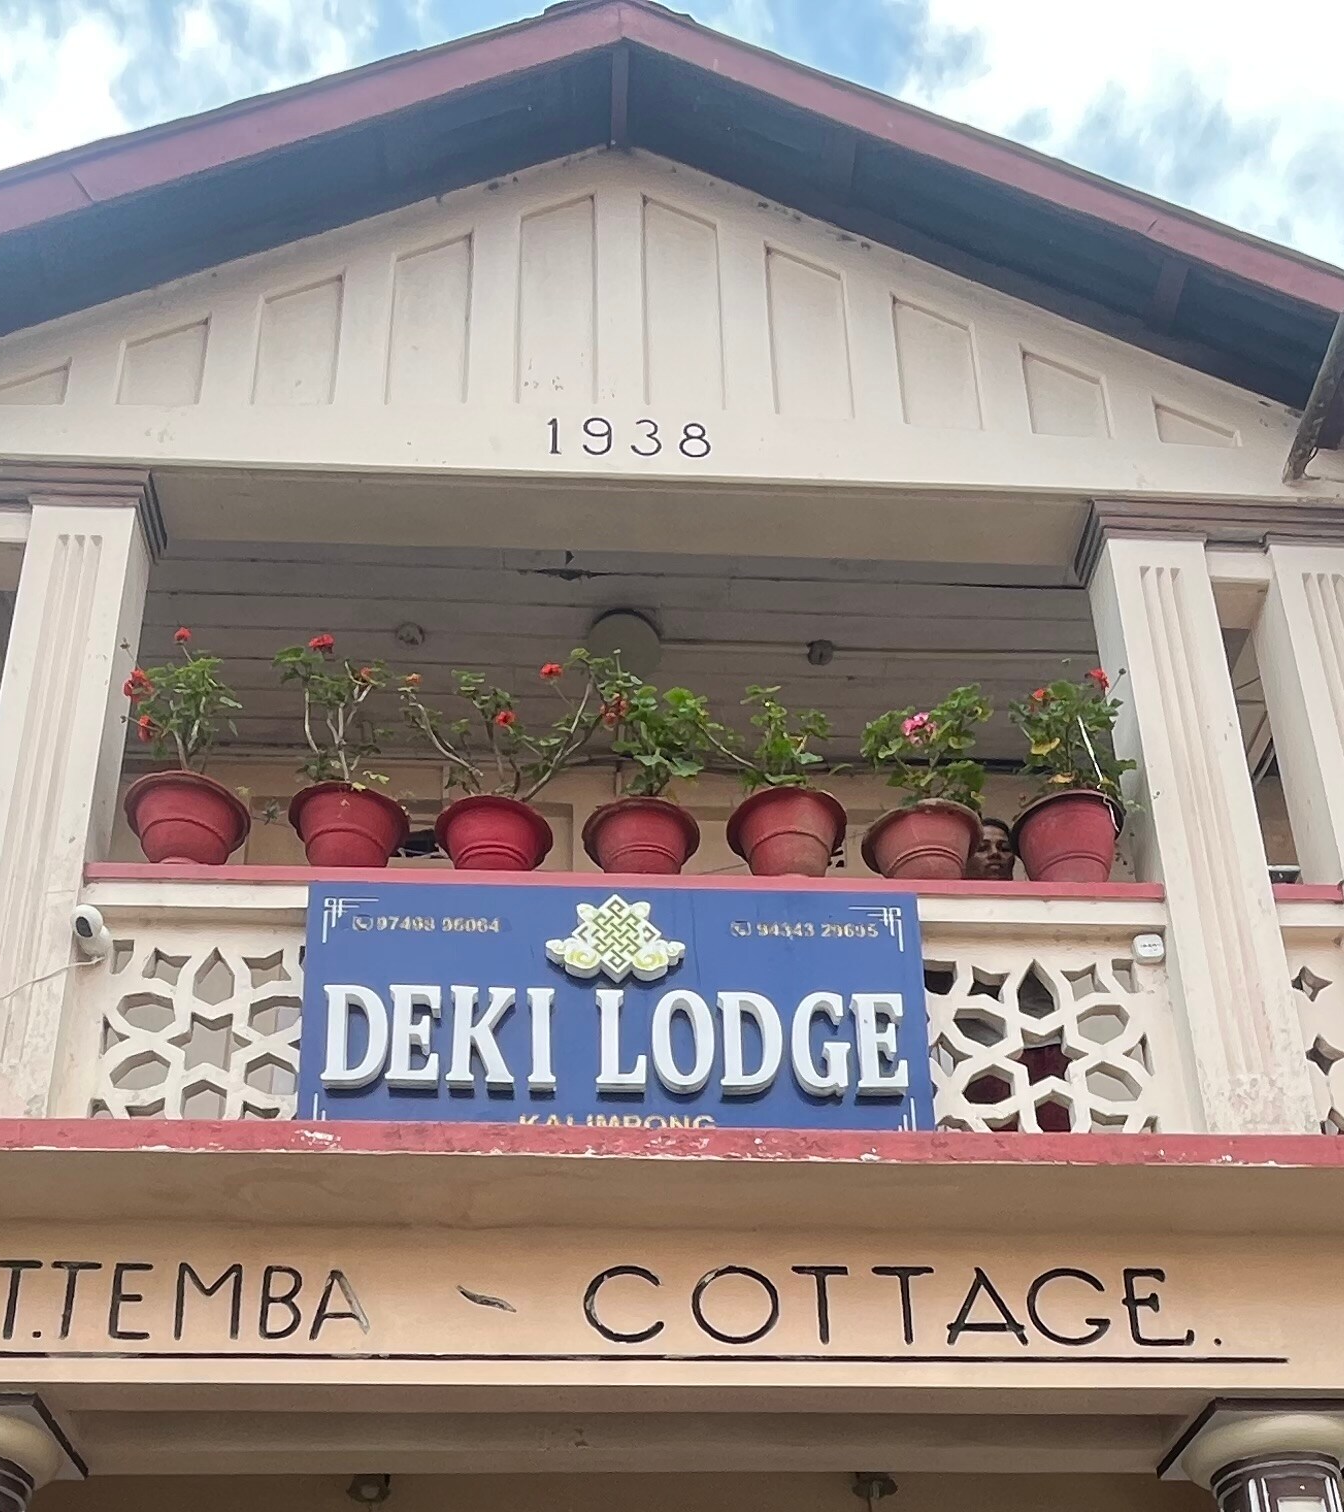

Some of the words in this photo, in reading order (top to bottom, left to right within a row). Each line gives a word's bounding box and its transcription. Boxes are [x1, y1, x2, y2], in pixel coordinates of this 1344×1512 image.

[547, 417, 711, 457] 1938
[320, 984, 557, 1092] DEKI
[595, 988, 909, 1097] LODGE
[582, 1264, 1223, 1346] COTTAGE.
